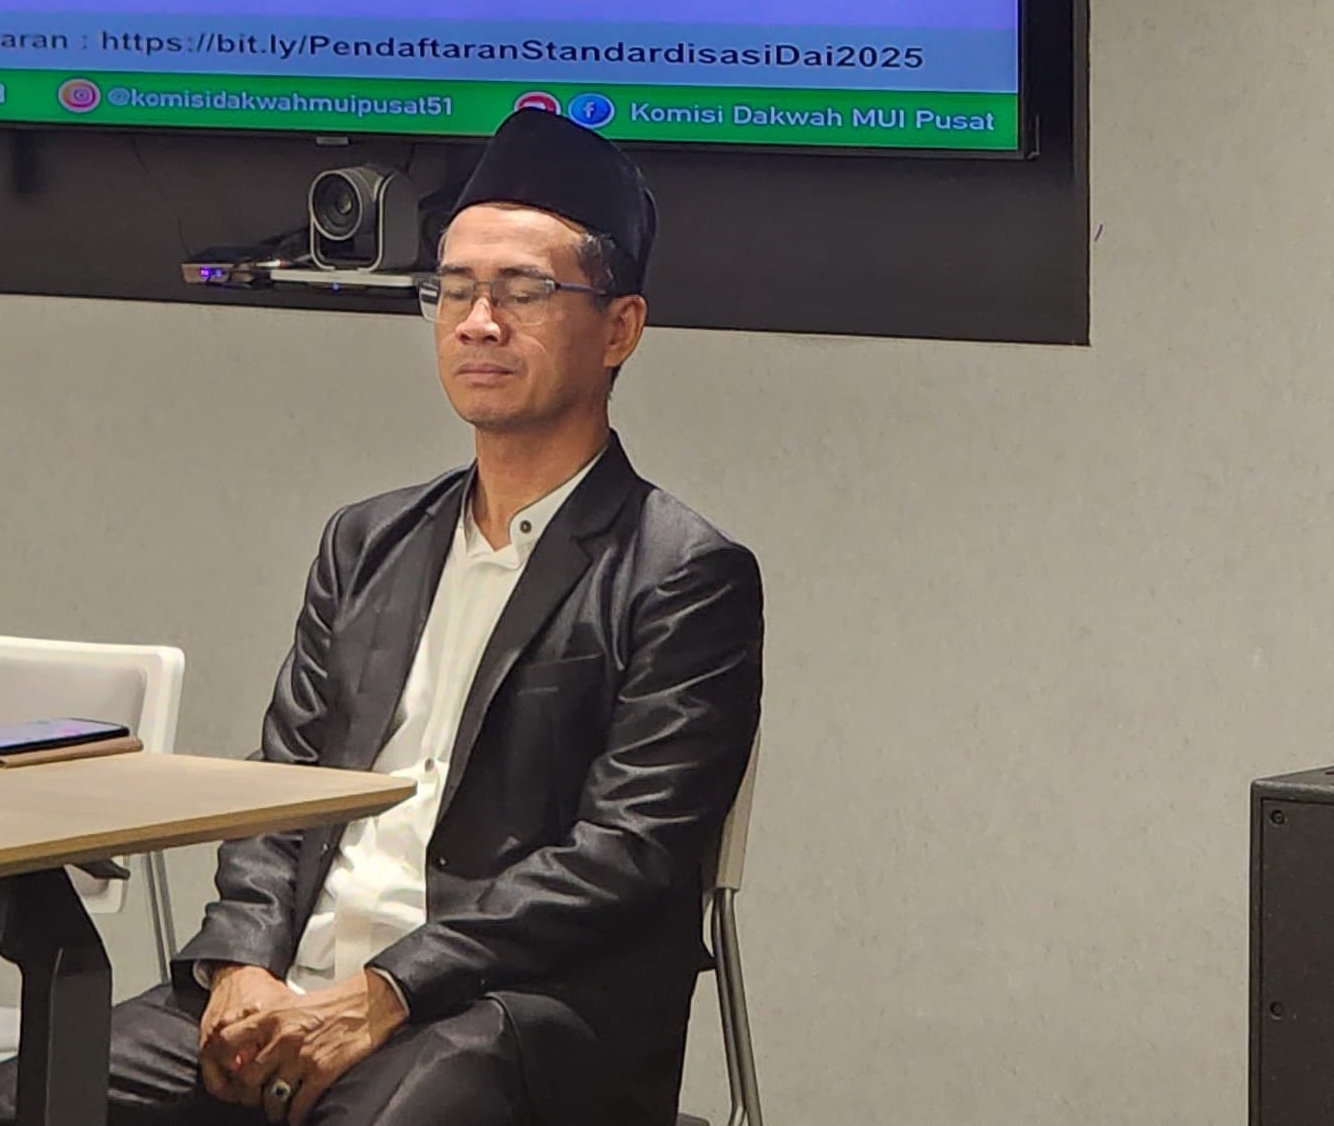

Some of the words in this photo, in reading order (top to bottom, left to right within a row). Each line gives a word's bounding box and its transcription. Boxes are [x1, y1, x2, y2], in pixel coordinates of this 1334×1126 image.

[101, 30, 924, 69] https://bit.ly/PendaftaranStandardisasiDai2025
[107, 87, 453, 117] @komisidakwahmuipusat51
[630, 101, 723, 125] Komisi
[733, 104, 842, 127] Dakwah
[852, 108, 905, 129] MUI
[915, 110, 995, 132] Pusat
